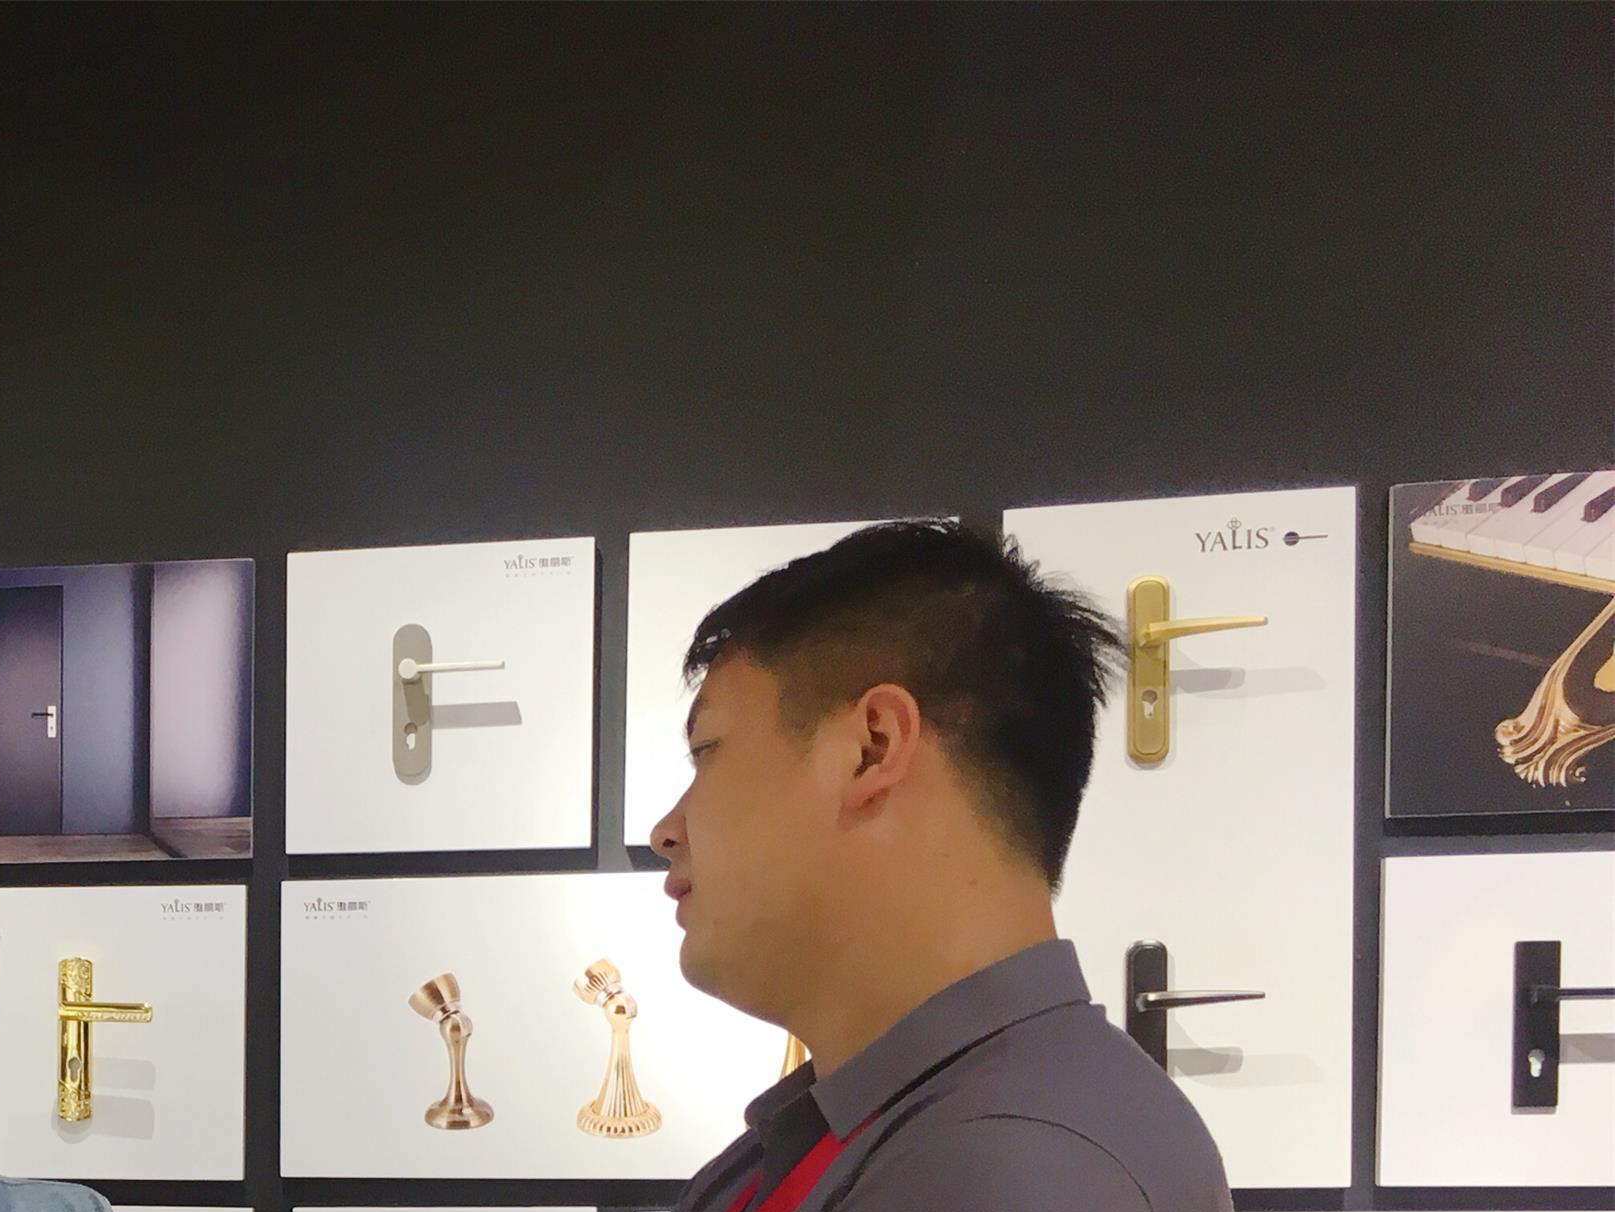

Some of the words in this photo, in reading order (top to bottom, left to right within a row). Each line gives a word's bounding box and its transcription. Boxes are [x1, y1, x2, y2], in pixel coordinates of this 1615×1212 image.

[1195, 517, 1269, 552] YALIS
[504, 554, 535, 569] YALIS
[160, 898, 190, 913] YALIS
[304, 897, 334, 912] YALIS
